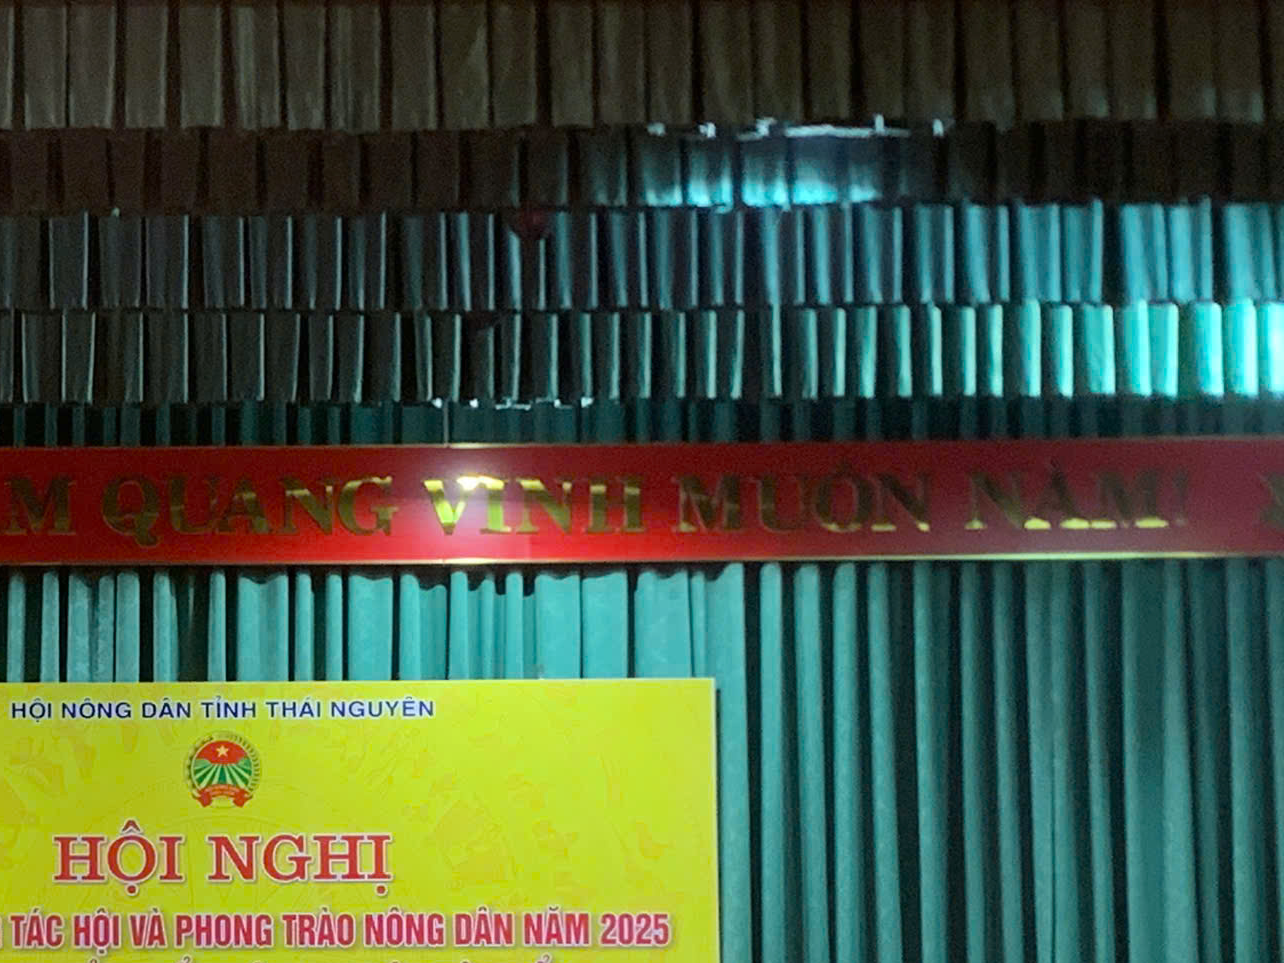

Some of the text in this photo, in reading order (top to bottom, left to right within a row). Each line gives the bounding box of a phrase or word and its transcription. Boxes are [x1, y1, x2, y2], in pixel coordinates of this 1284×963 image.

[102, 475, 398, 547] QUANG
[422, 474, 645, 535] VINH
[671, 457, 930, 533] MUÔN
[11, 696, 434, 721] HỘI NÔNG DÂN TỈNH THÁI NGUYÊN
[54, 820, 393, 893] HỘI NGHỊ
[10, 908, 63, 948] TÁC
[73, 907, 120, 955] HỘI
[129, 907, 166, 948] VÀ
[175, 913, 272, 947] PHONG
[282, 907, 354, 946] TRÀO
[364, 907, 444, 946] NÔNG
[455, 906, 513, 946] DÂN
[523, 906, 590, 945] NĂM
[600, 913, 669, 945] 2025
